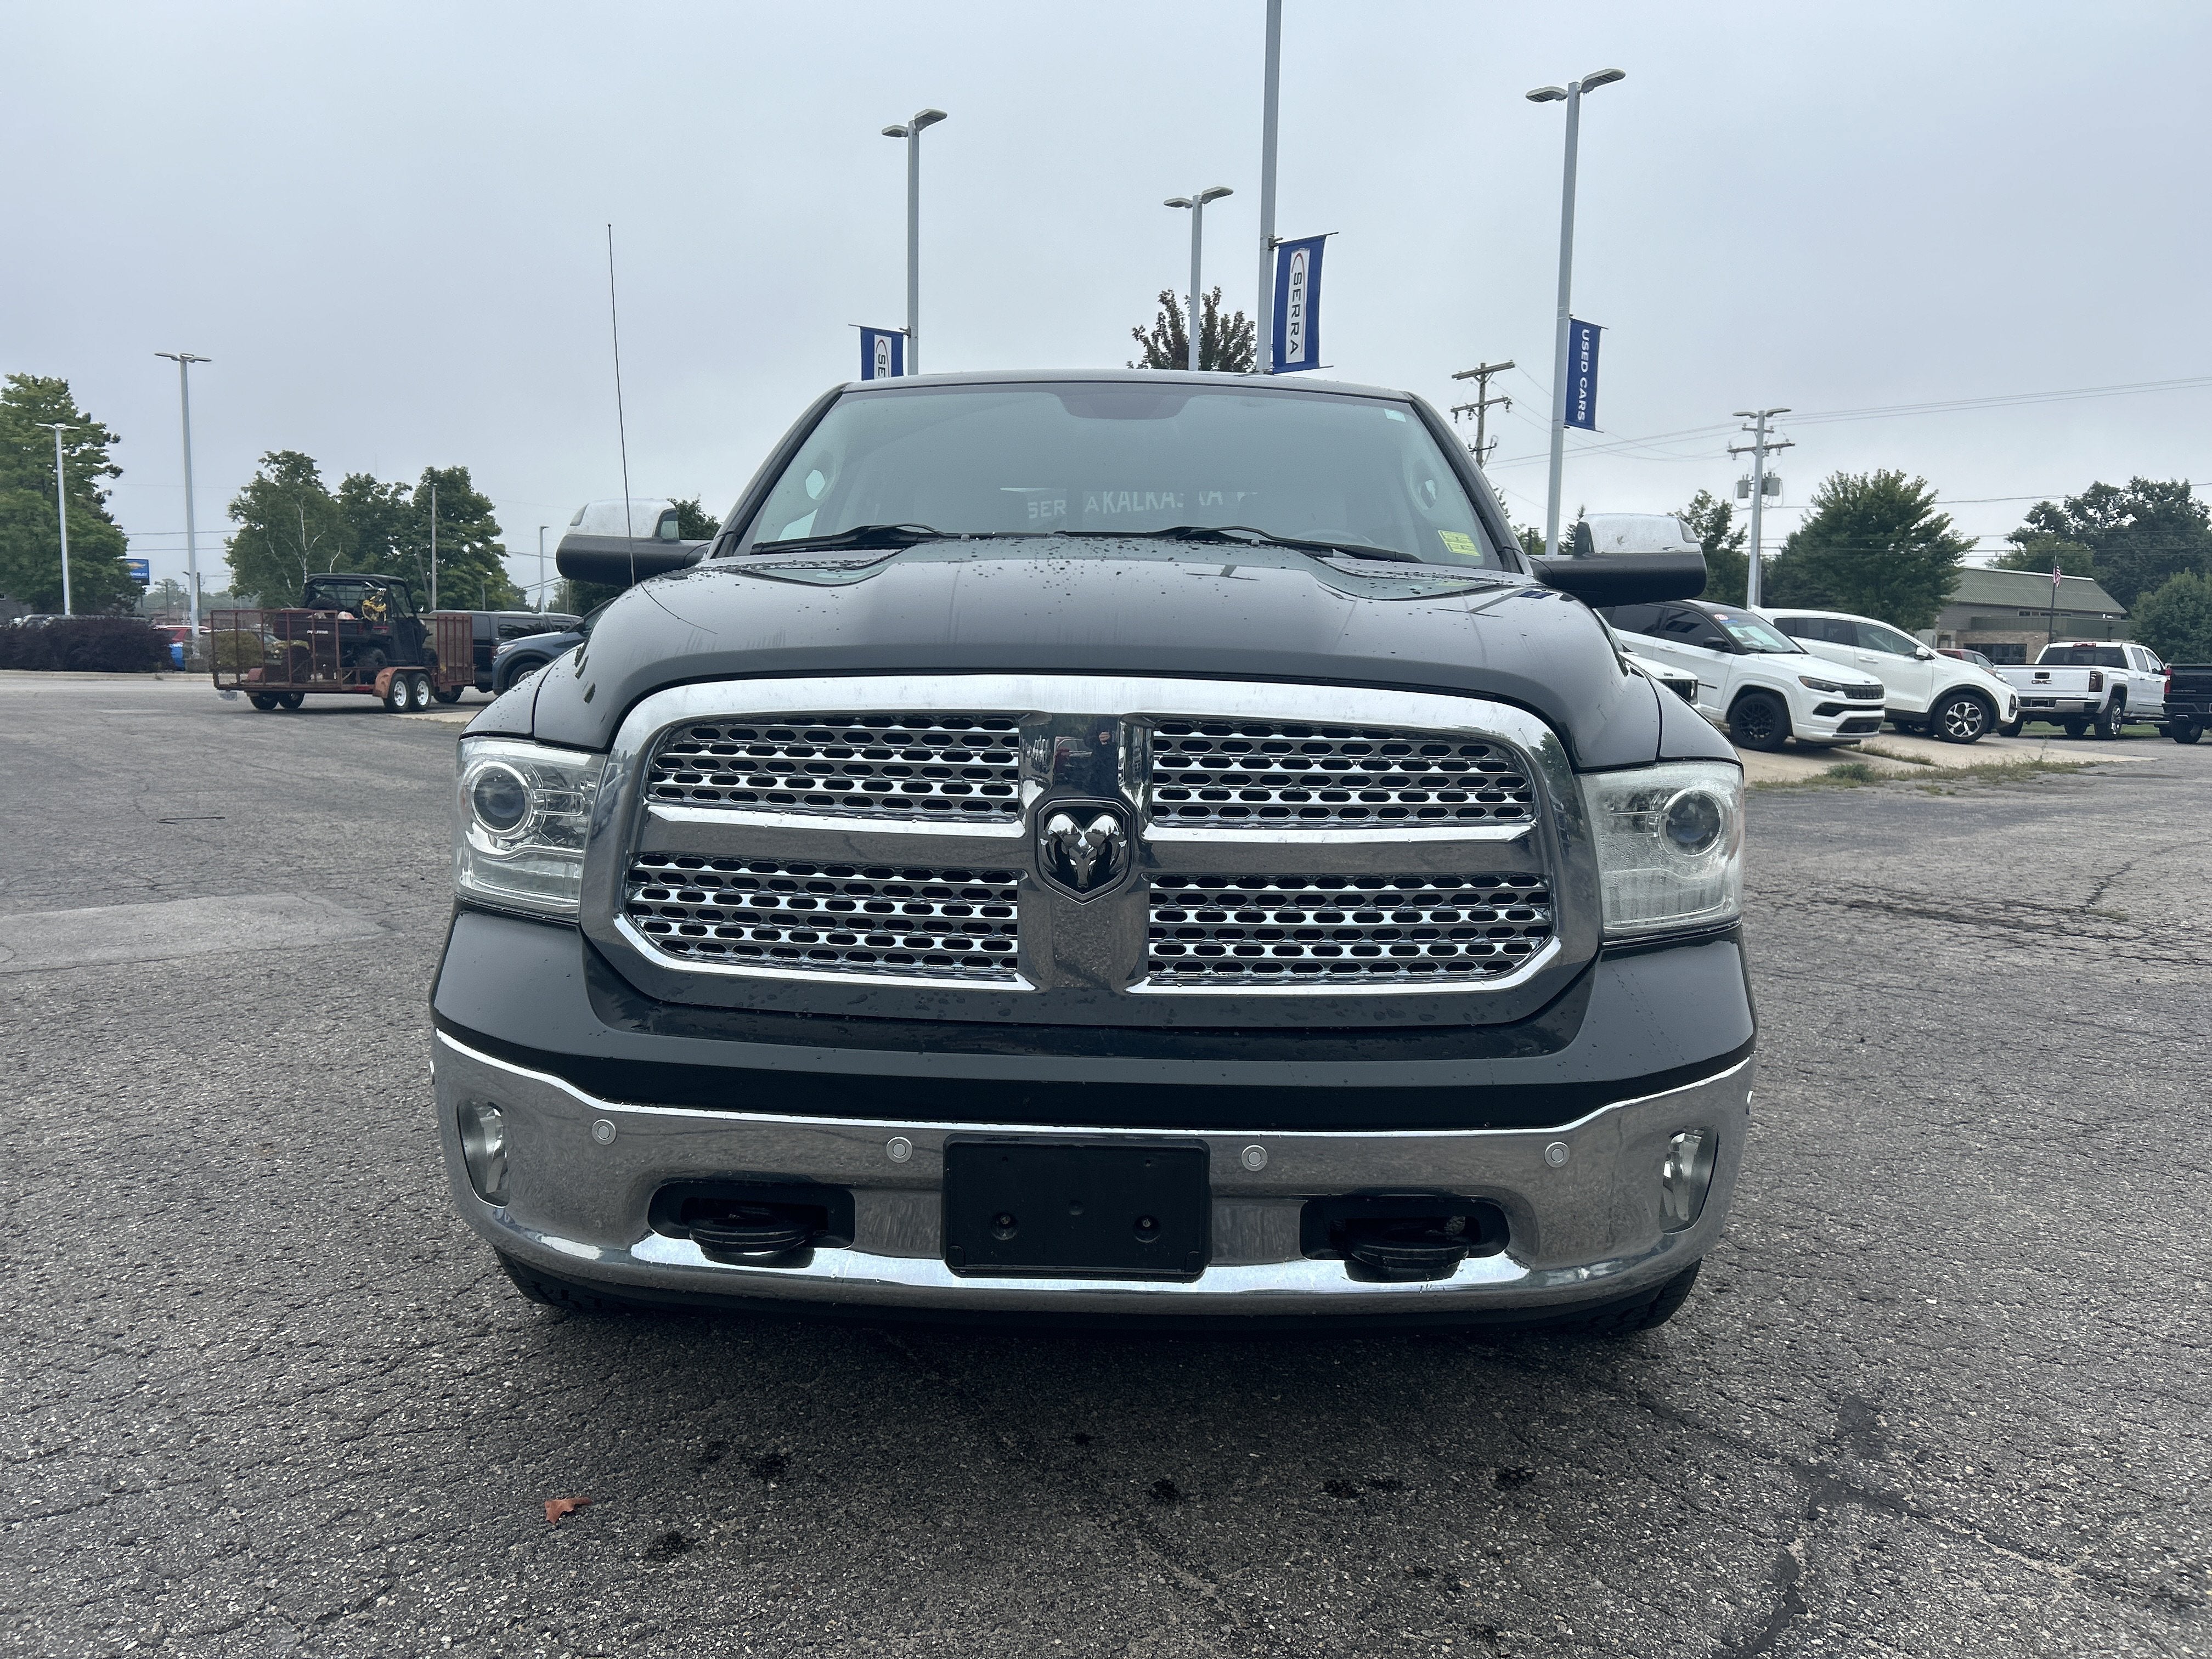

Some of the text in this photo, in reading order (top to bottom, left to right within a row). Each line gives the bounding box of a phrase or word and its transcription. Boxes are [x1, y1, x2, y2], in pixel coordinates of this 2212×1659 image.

[1290, 272, 1302, 355] SERRA
[1577, 329, 1590, 421] USED CARS
